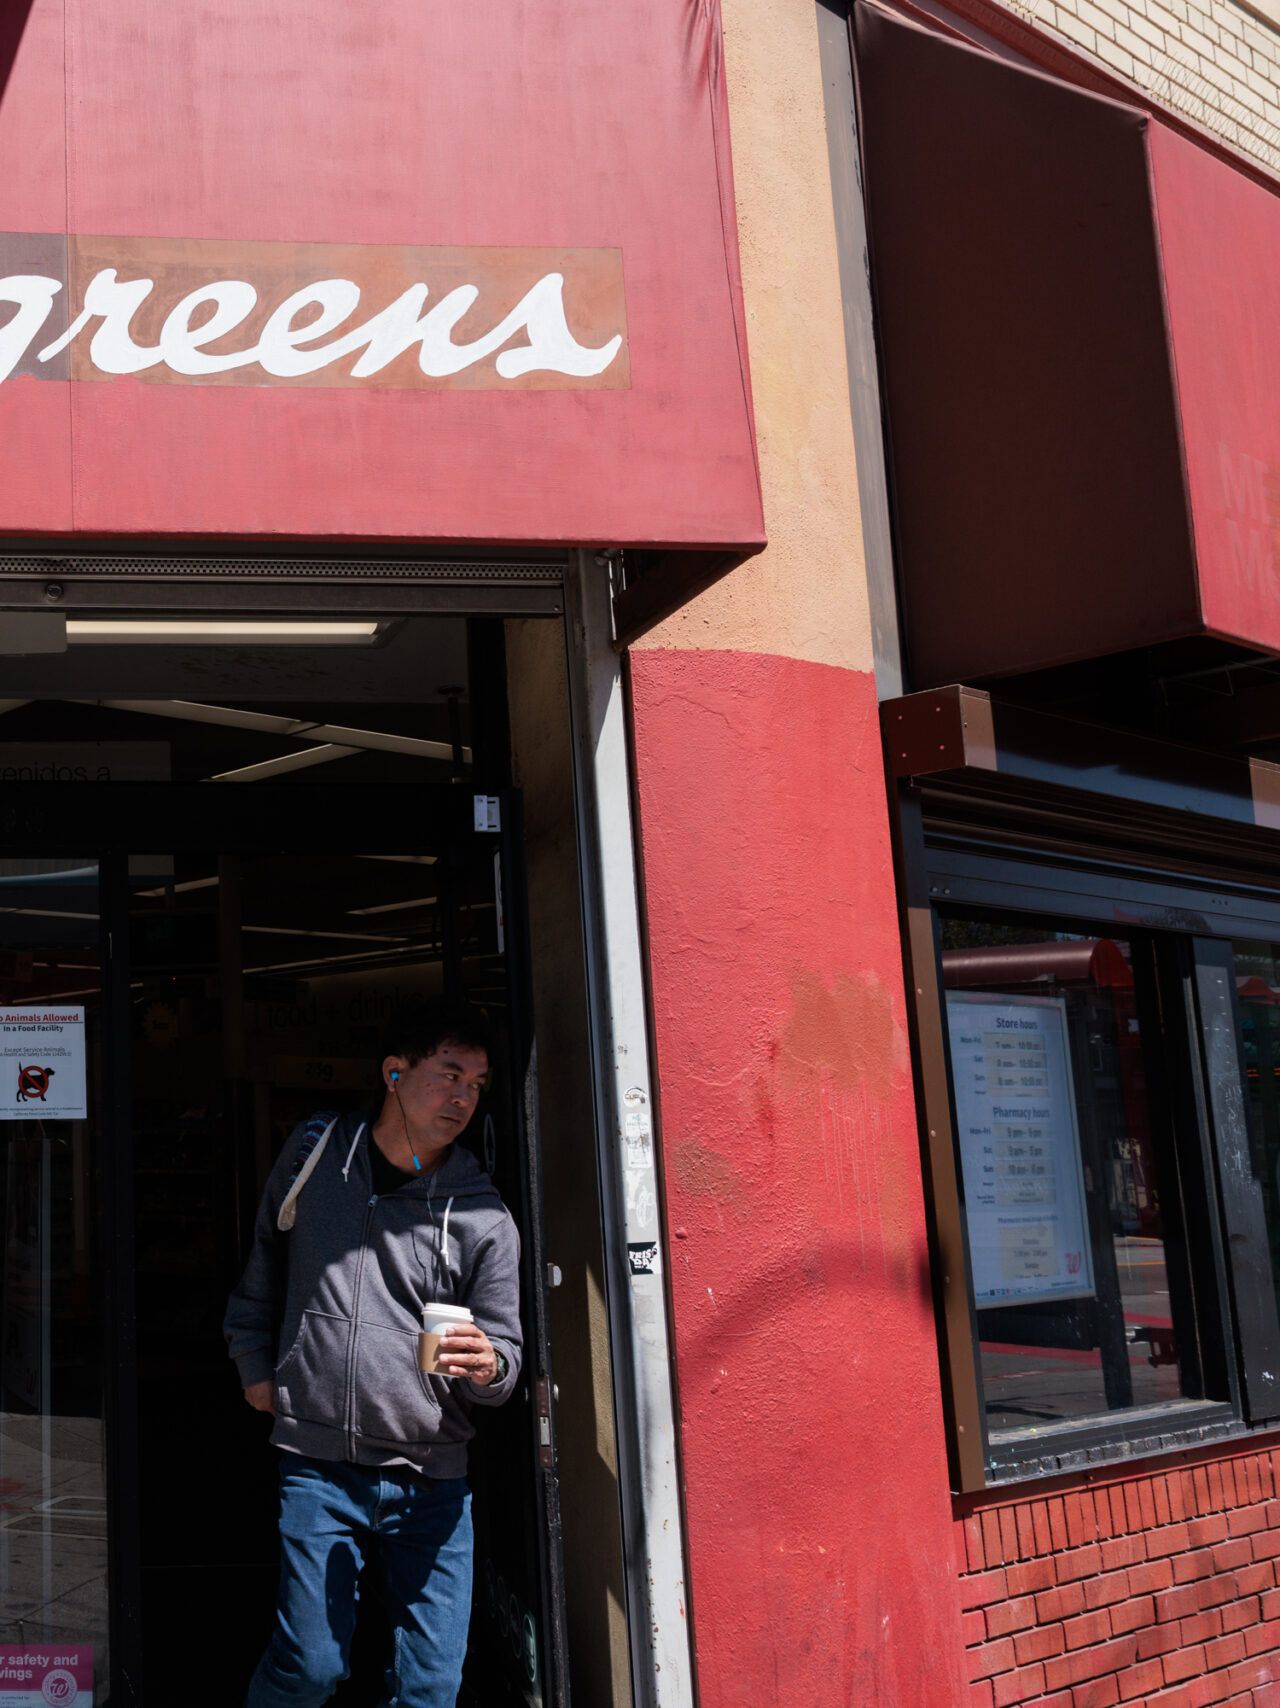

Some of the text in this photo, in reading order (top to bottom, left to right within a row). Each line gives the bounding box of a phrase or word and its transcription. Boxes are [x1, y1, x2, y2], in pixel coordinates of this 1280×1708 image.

[5, 1013, 41, 1022] Animals
[42, 1013, 79, 1022] Allowed
[37, 1025, 64, 1033] Facility
[996, 1018, 1038, 1030] Store hours
[993, 1107, 1050, 1120] Pharmacy hours
[8, 1653, 50, 1668] safety
[53, 1653, 78, 1666] and
